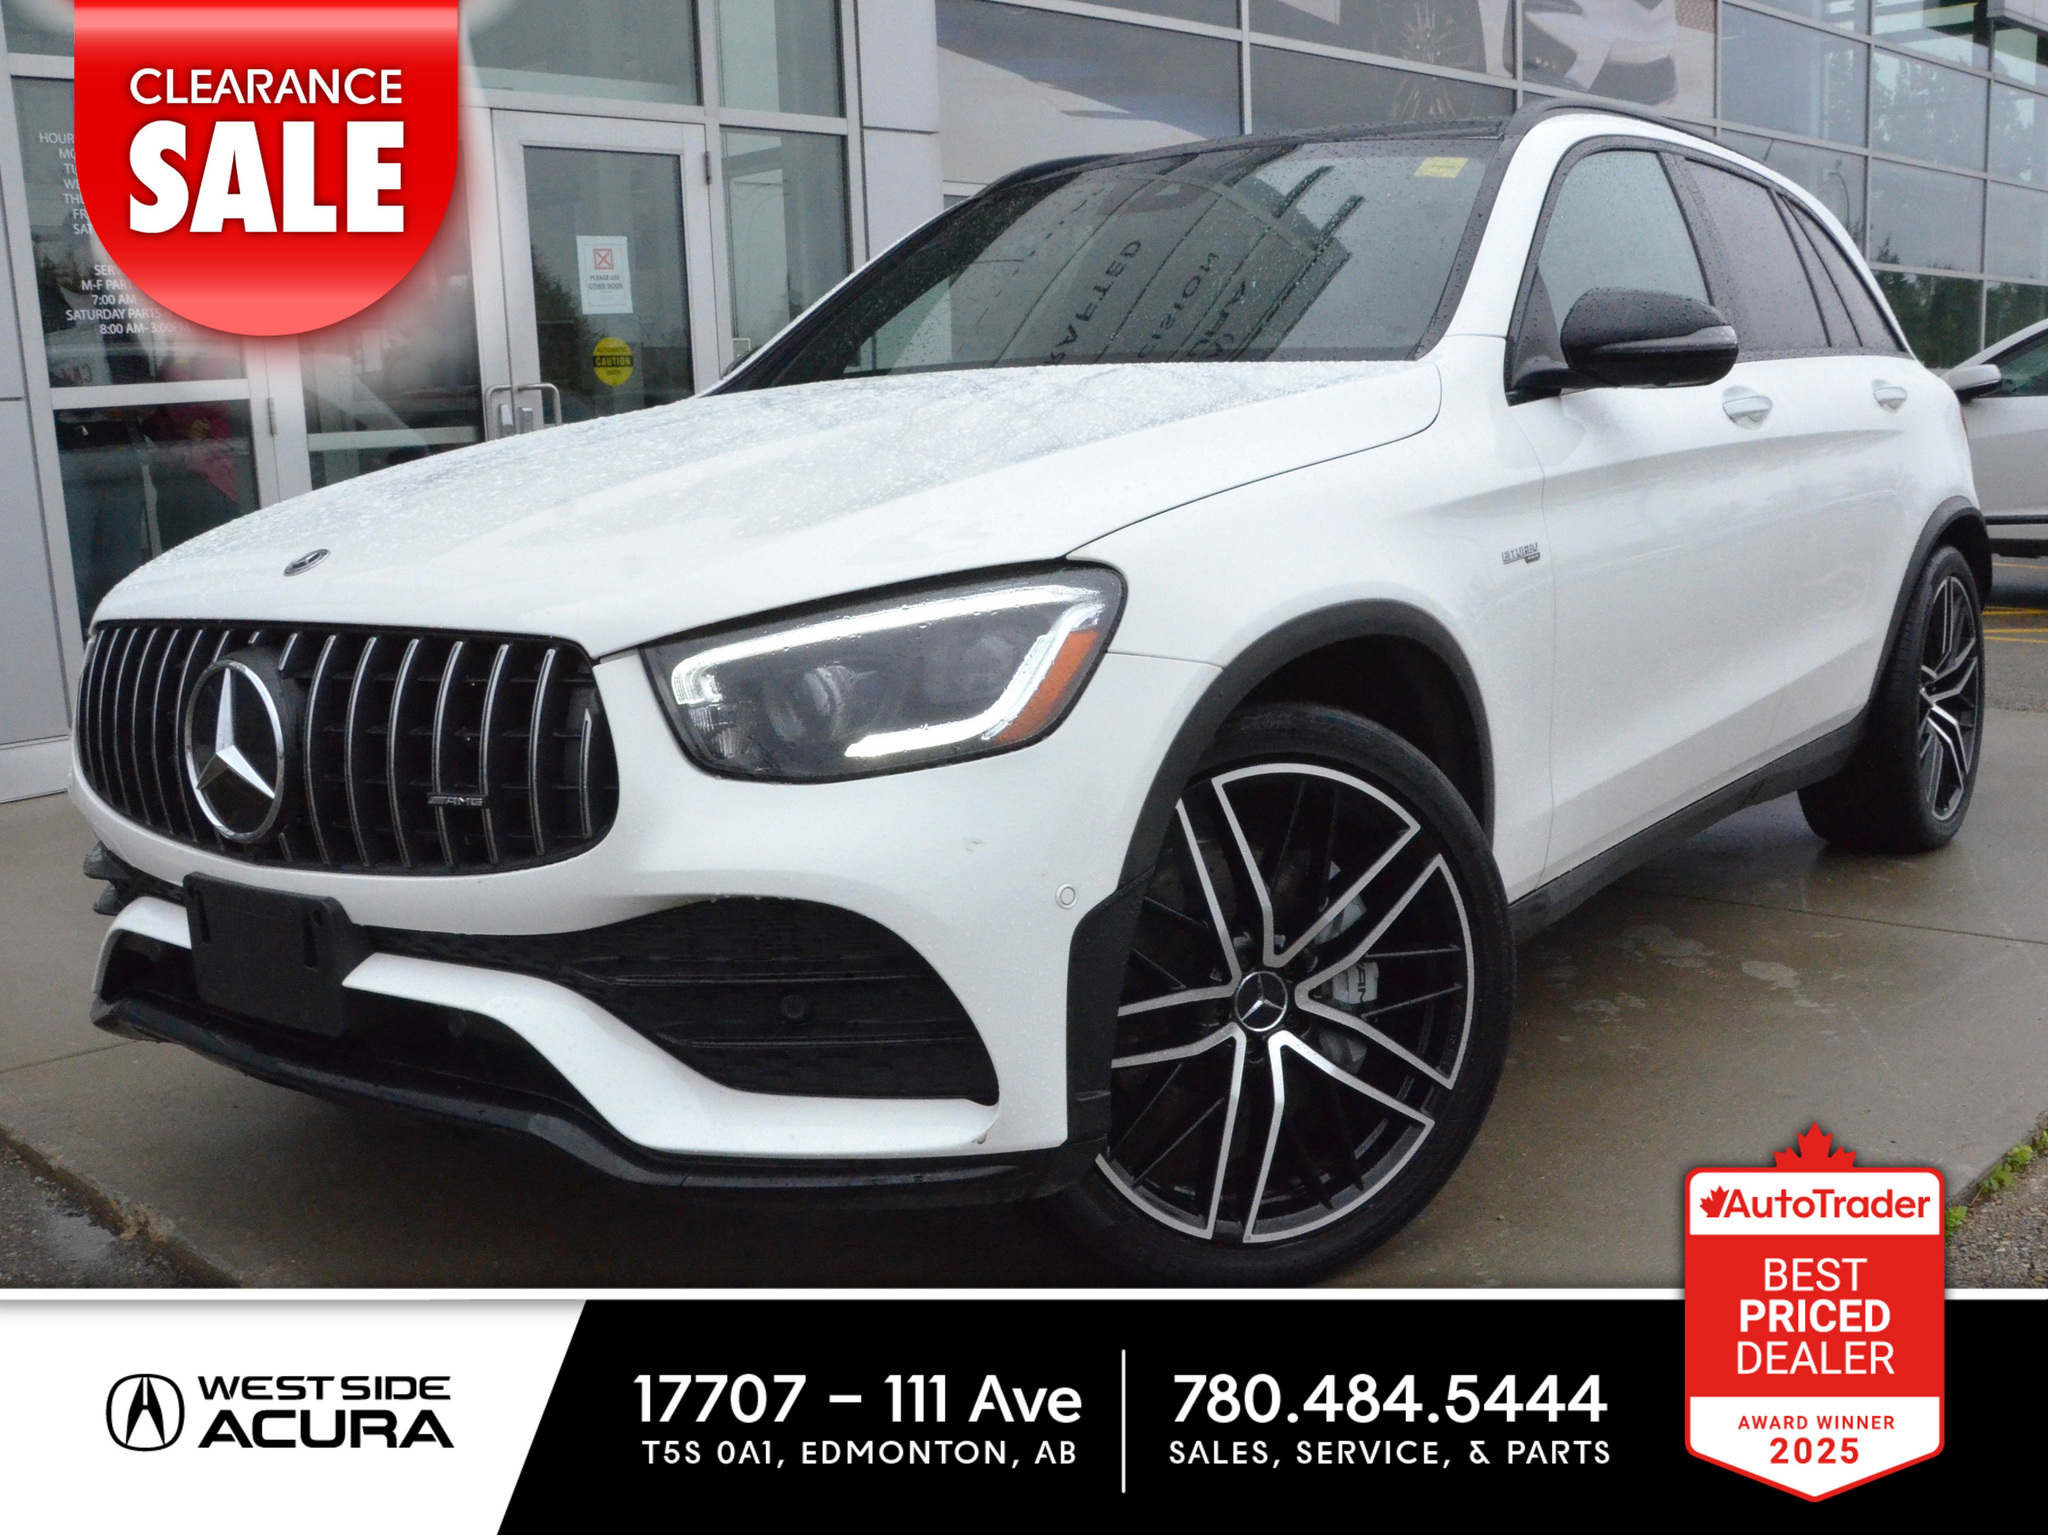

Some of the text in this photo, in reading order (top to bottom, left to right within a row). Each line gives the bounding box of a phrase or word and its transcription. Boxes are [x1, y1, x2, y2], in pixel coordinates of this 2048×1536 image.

[39, 132, 74, 144] HOUR
[59, 148, 75, 159] MO
[64, 163, 77, 174] TU
[73, 208, 88, 220] FR
[94, 264, 121, 276] SERV
[81, 279, 136, 291] M-F PART
[92, 294, 115, 306] 7:00
[118, 294, 137, 305] AM
[65, 308, 125, 321] SATURDAY
[127, 308, 161, 319] PARTS
[100, 323, 124, 335] 8:00
[595, 356, 631, 366] CAUTION
[444, 796, 483, 806] AMG
